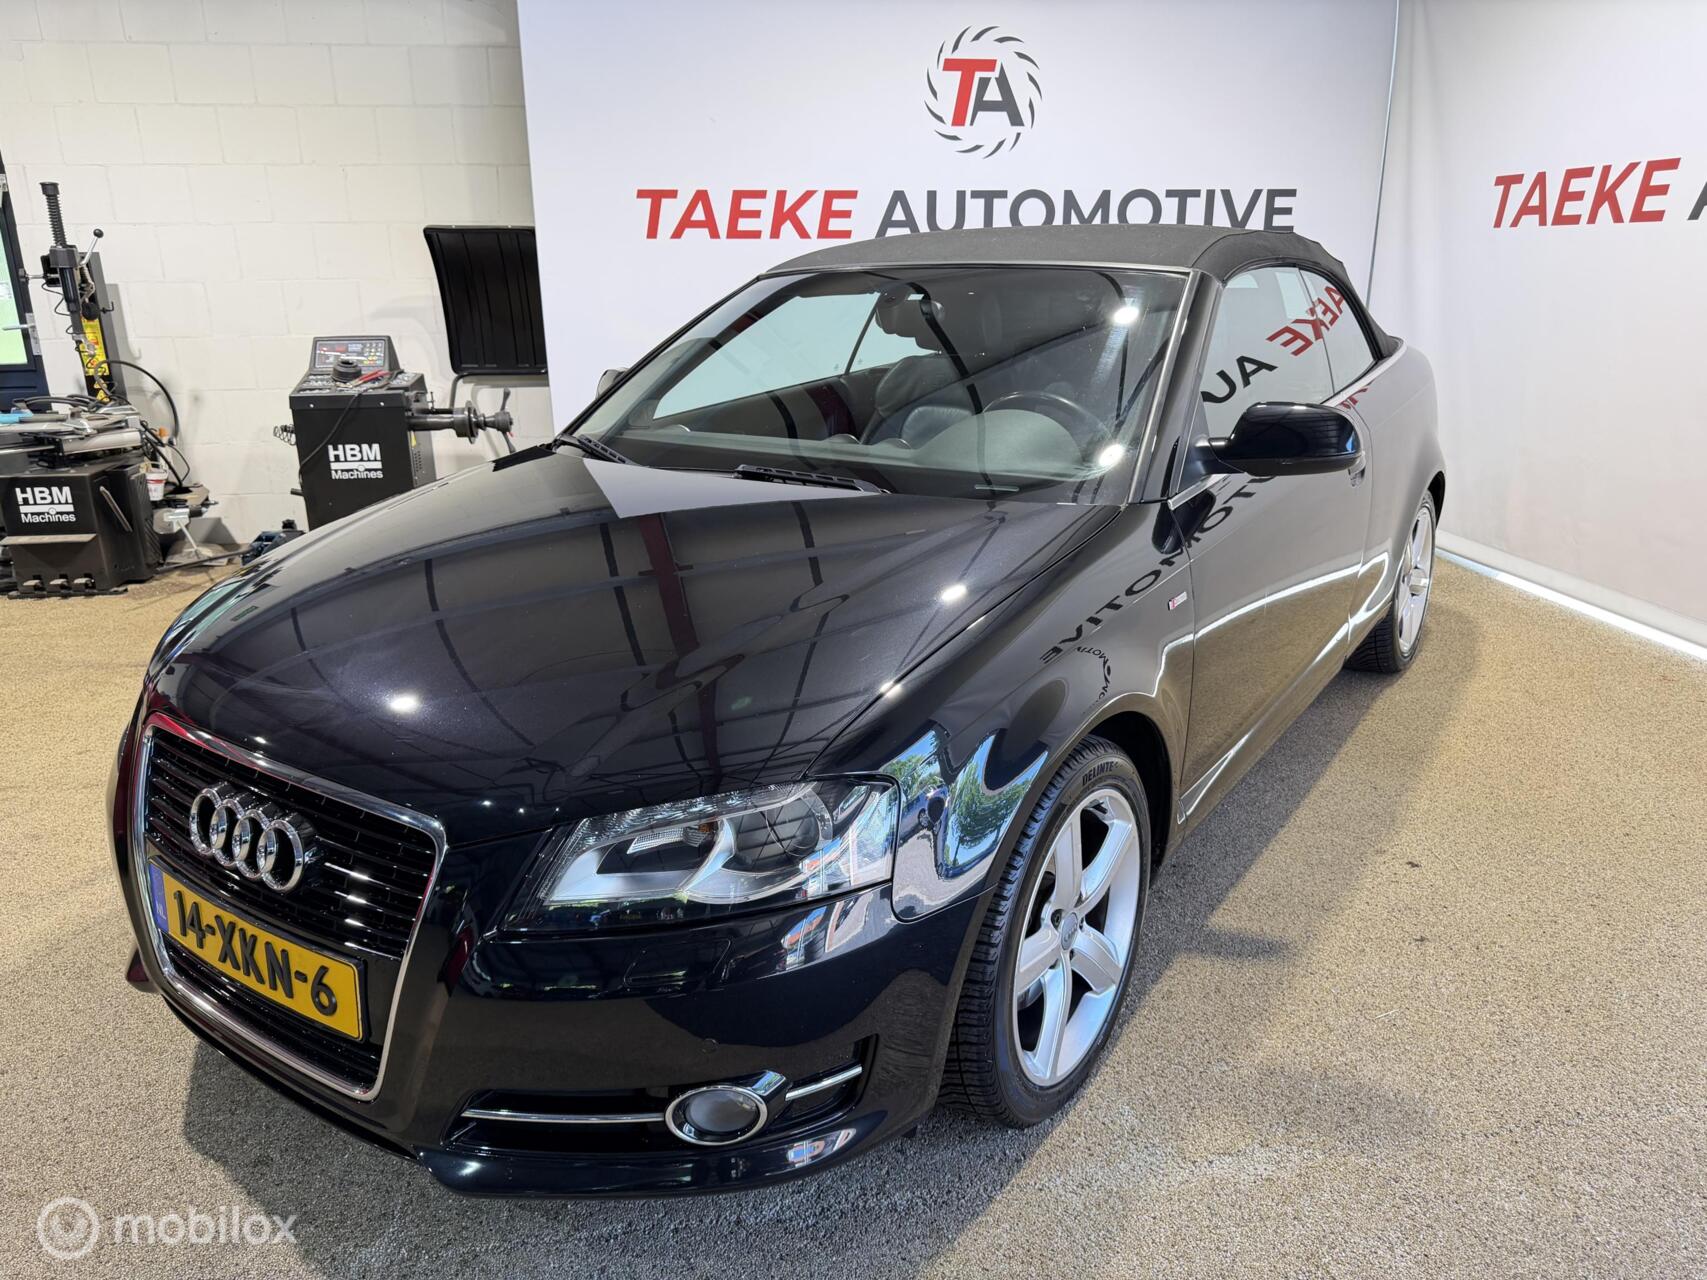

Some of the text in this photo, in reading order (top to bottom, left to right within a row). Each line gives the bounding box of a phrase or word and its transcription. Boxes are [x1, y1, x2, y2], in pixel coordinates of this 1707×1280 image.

[942, 58, 1025, 127] TA
[1493, 157, 1682, 229] TAEKE
[636, 188, 1298, 240] TAEKE AUTOMOTIVE
[327, 443, 382, 462] HBM
[331, 469, 384, 480] Machines
[15, 486, 73, 505] HBM
[20, 512, 77, 523] Machines
[173, 889, 338, 1017] 14-XKN-6
